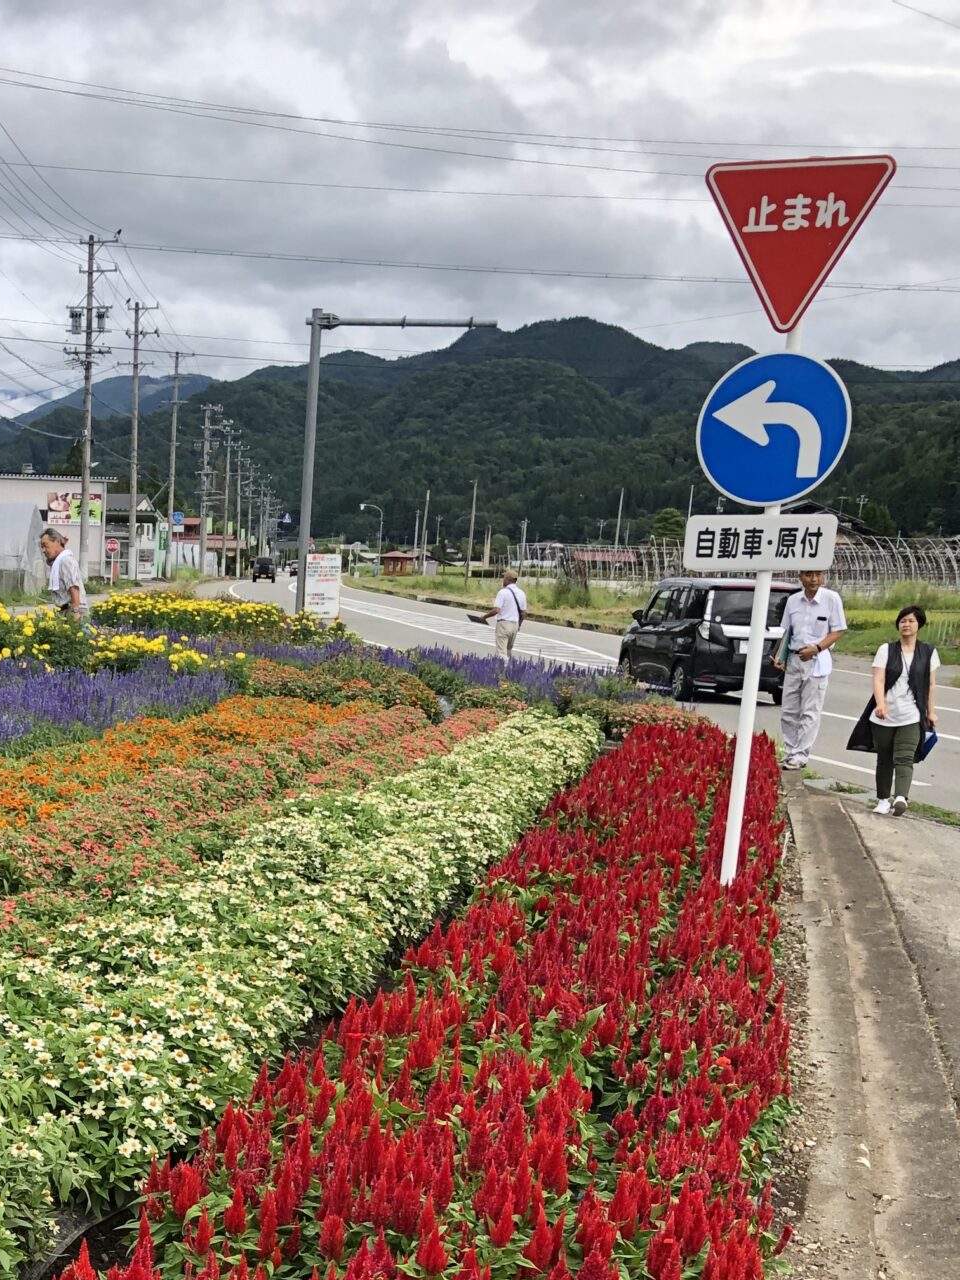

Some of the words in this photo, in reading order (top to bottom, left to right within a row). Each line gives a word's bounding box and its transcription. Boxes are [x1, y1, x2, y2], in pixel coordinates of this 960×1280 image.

[741, 191, 851, 233] 止まれ
[695, 526, 824, 560] 自動車・原付
